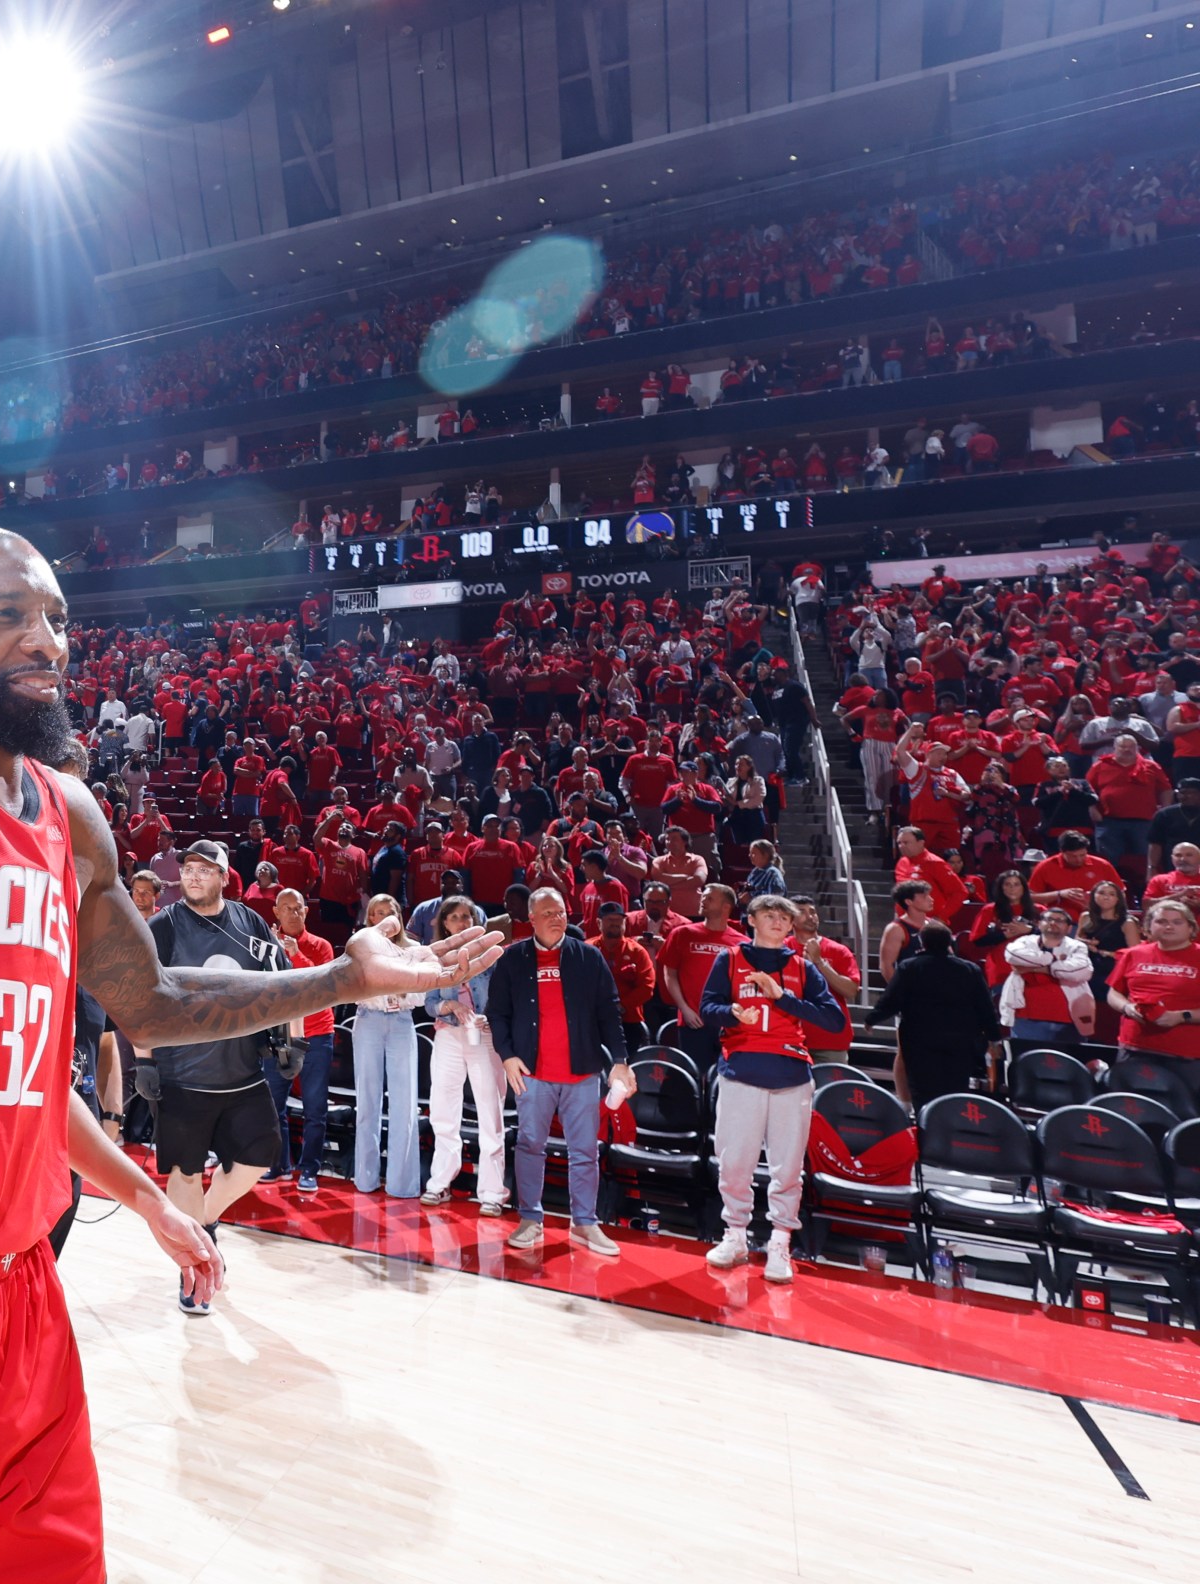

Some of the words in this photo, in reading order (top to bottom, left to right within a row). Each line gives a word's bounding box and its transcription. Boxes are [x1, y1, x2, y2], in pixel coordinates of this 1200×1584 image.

[711, 518, 719, 535] 1
[743, 515, 754, 532] 5
[779, 512, 787, 528] 1
[523, 526, 549, 547] 0.0
[584, 519, 612, 547] 94
[460, 531, 493, 558] 109
[578, 571, 651, 588] TOYOTA
[442, 582, 507, 597] TOYOTA
[694, 943, 726, 953] LIFTO
[761, 1004, 770, 1032] 1
